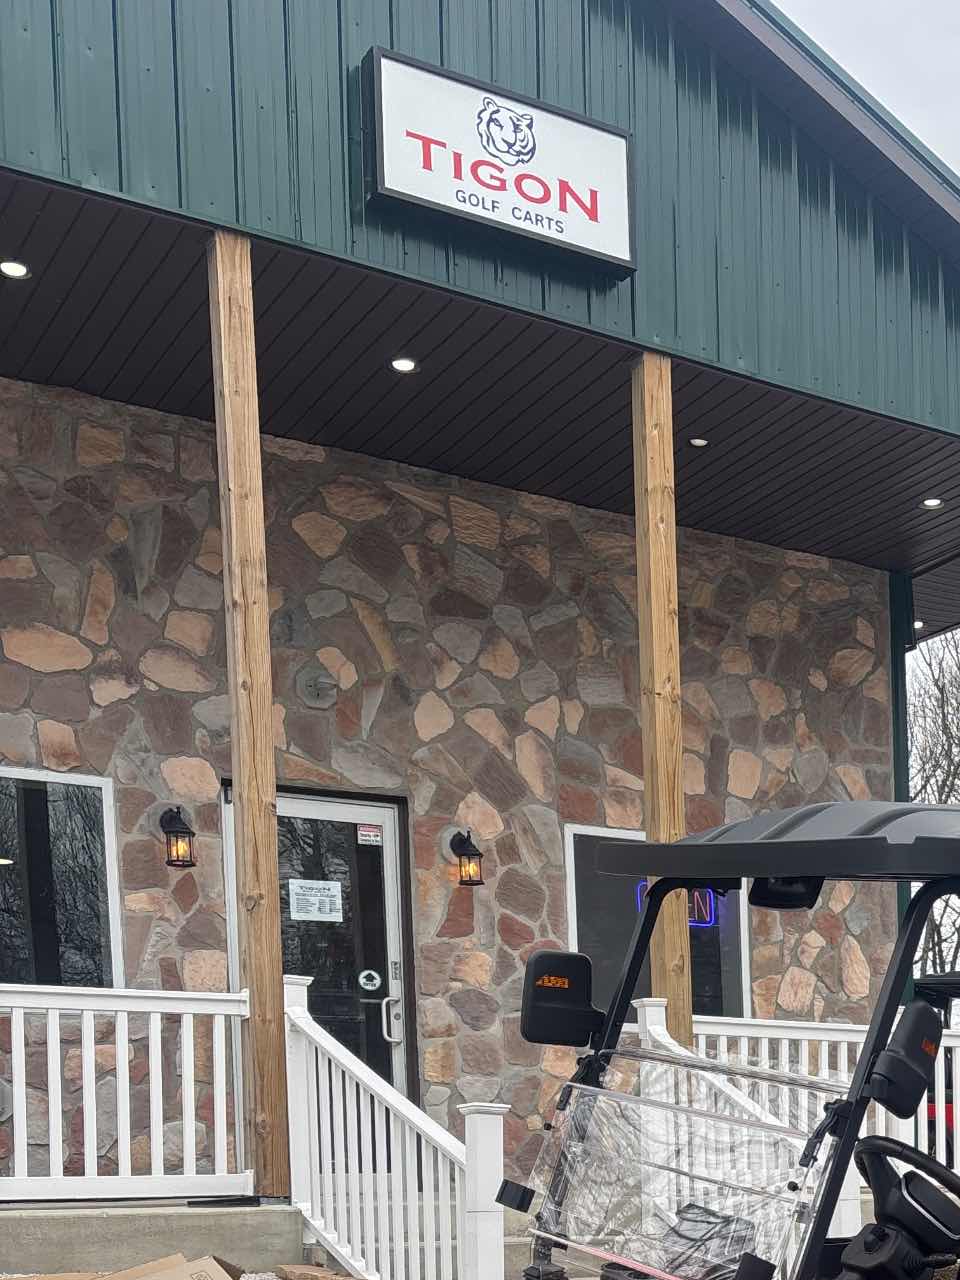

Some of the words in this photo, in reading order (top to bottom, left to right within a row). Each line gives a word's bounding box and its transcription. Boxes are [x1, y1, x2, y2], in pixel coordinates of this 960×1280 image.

[405, 128, 600, 223] TIGON
[455, 189, 501, 214] GOLF
[511, 206, 565, 234] CARTS
